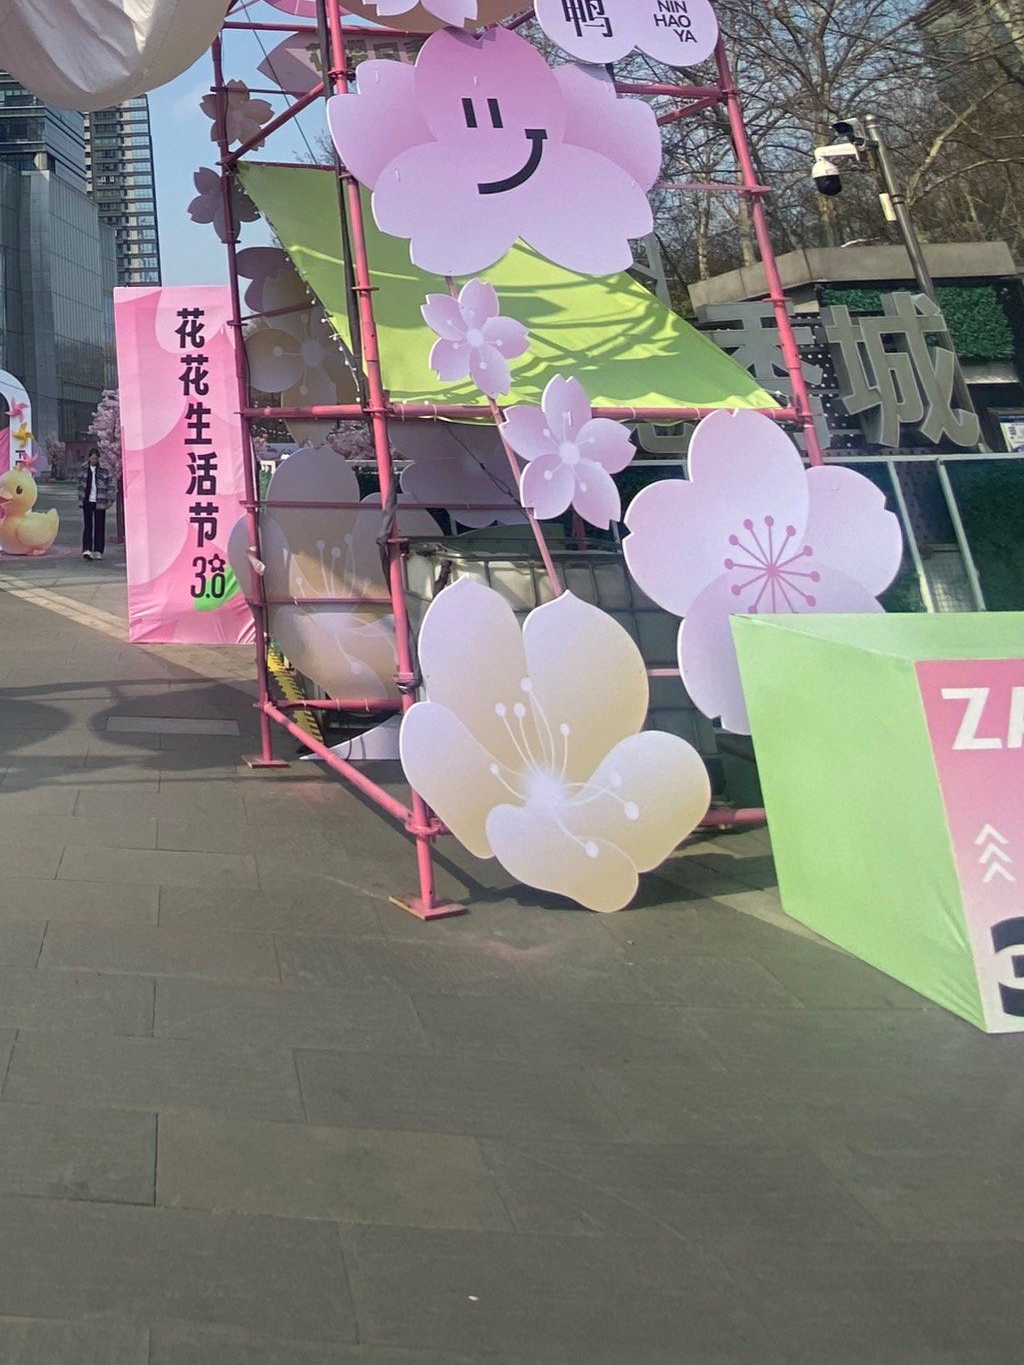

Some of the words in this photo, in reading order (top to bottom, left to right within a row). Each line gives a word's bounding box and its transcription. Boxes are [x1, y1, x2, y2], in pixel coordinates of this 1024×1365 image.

[656, 0, 688, 14] NIN
[653, 13, 692, 28] HAO
[673, 28, 698, 43] YA
[174, 307, 220, 549] 花花生活节
